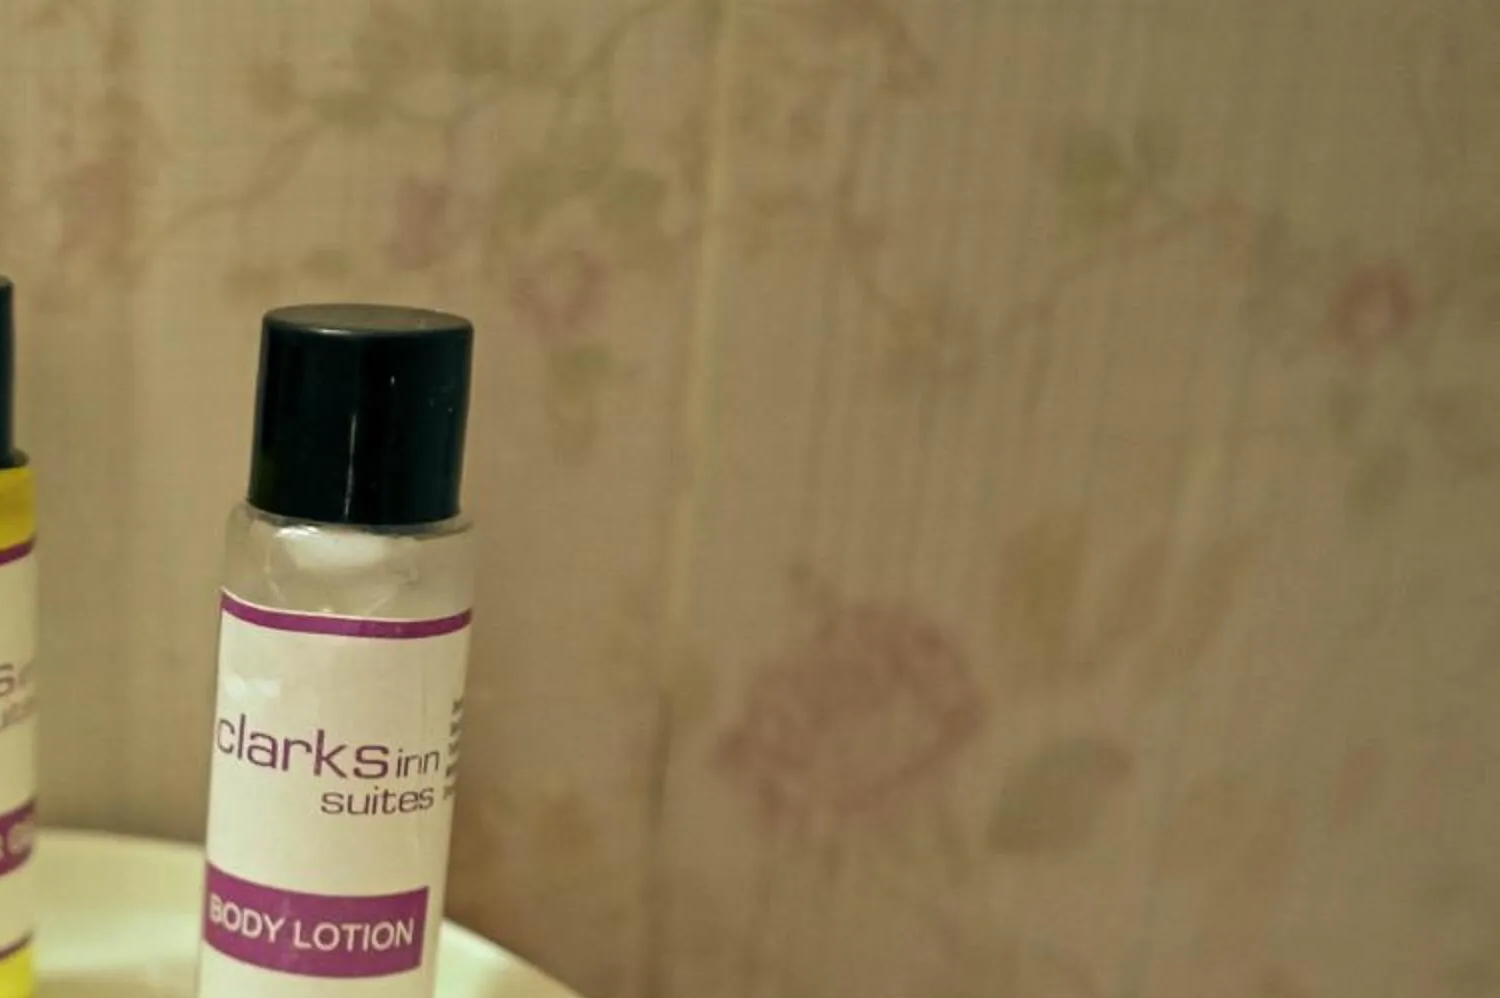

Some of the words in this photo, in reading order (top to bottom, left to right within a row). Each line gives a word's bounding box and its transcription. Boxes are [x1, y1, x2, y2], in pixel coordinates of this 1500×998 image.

[215, 713, 389, 780] clarks
[396, 747, 440, 778] inn
[320, 784, 435, 817] suites
[209, 892, 287, 942] BODY
[293, 917, 415, 953] LOTION
